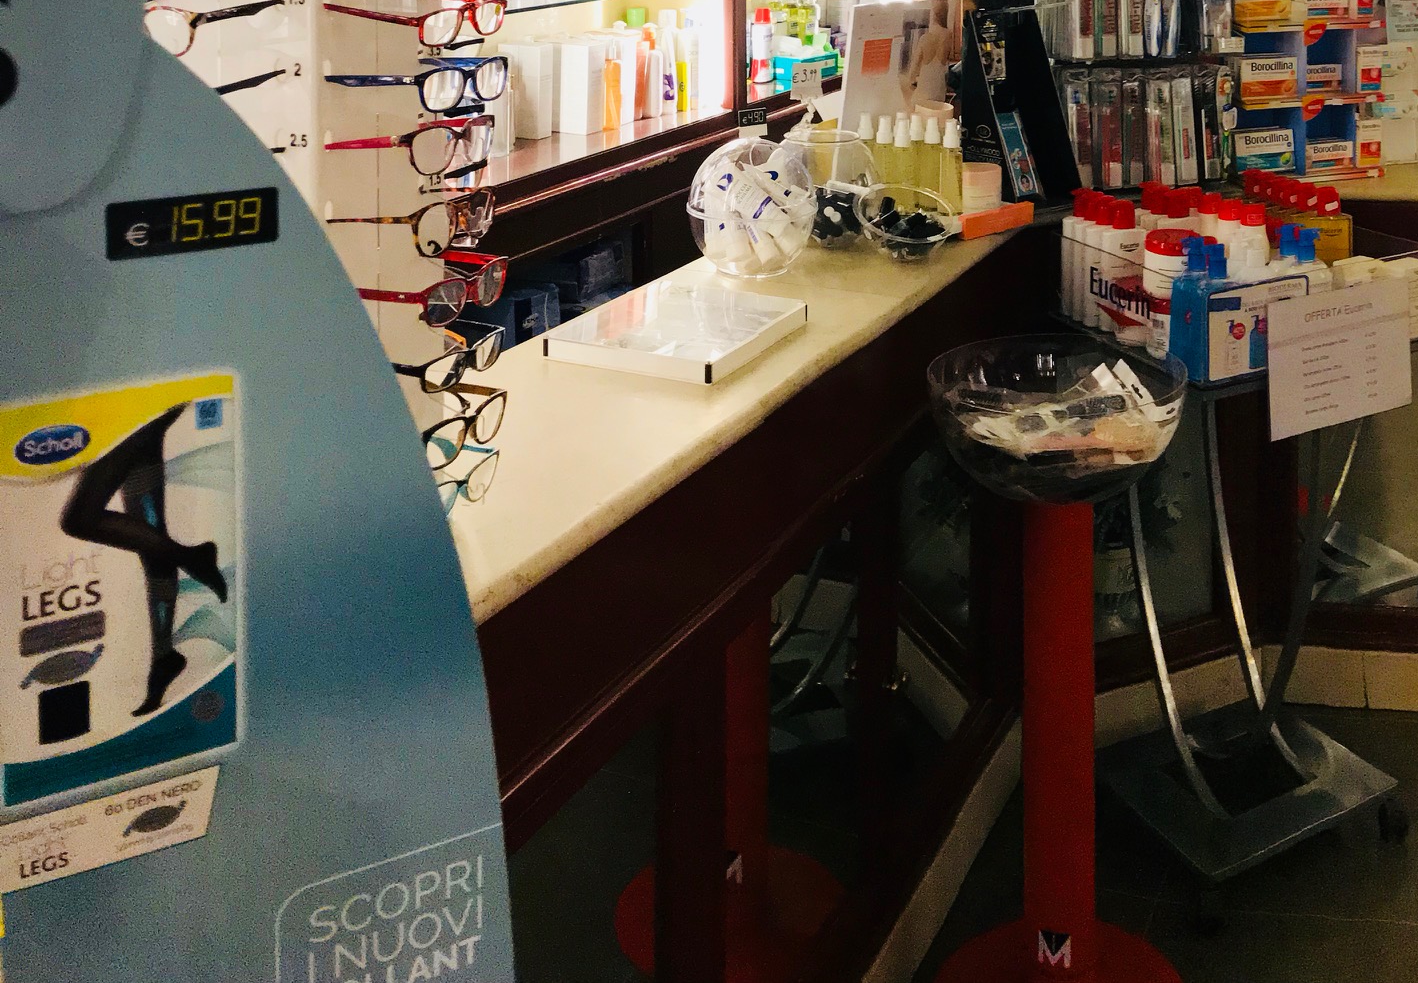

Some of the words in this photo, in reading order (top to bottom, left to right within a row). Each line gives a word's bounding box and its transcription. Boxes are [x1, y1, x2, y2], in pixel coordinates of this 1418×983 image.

[293, 63, 302, 77] 2
[1250, 60, 1294, 73] Borocillina
[1306, 65, 1336, 75] orocillina
[289, 133, 308, 148] 2.5
[1244, 132, 1289, 146] Borocillina
[1313, 143, 1348, 154] Borocillina
[170, 196, 263, 244] 15.99
[1089, 265, 1151, 321] Eucerin
[1304, 307, 1342, 323] OFFERTA
[22, 433, 86, 459] Scholl
[22, 579, 102, 622] LEGS
[19, 851, 70, 879] LEGS
[309, 854, 483, 943] SCOPRI
[334, 895, 483, 979] NUOVI
